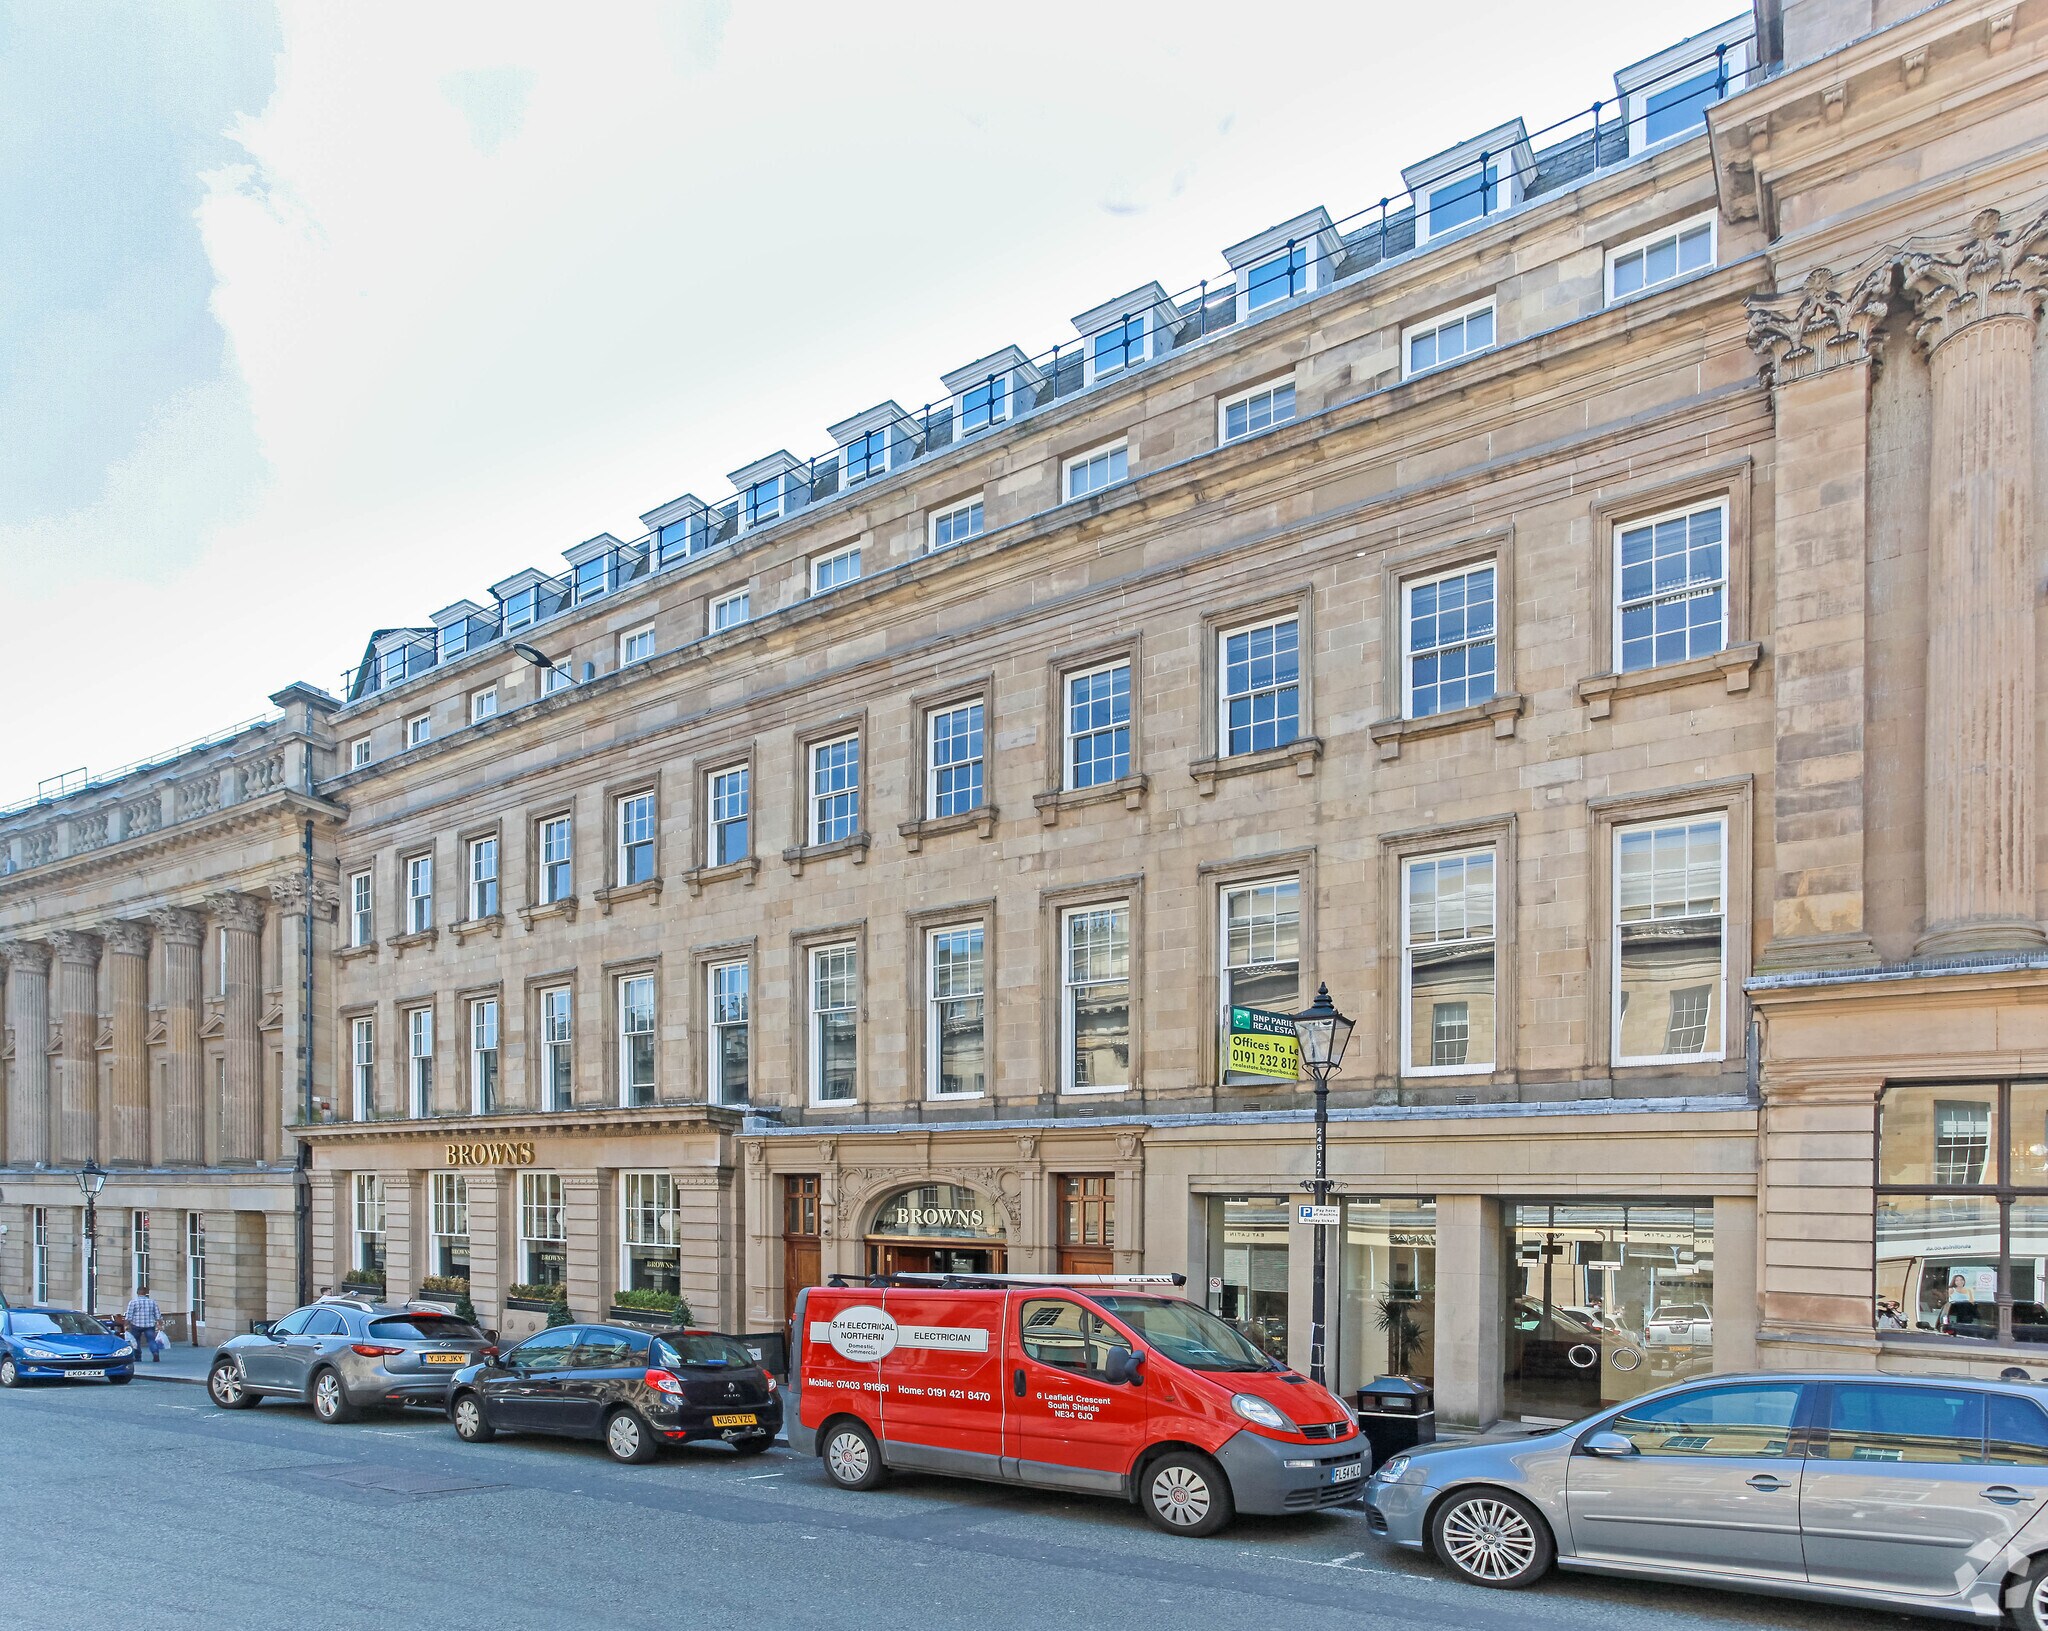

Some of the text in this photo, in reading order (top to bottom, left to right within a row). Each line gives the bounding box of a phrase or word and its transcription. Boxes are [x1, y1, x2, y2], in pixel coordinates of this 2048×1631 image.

[1253, 1013, 1269, 1022] BNP
[1253, 1022, 1273, 1032] REAL
[1233, 1036, 1269, 1050] Offices
[1273, 1043, 1285, 1053] To
[1233, 1049, 1297, 1070] 0191 232 812
[445, 1142, 535, 1165] BROWNS
[896, 1207, 984, 1226] BROWNS
[1303, 1207, 1312, 1217] P
[646, 1260, 674, 1268] BROWNS
[847, 1321, 895, 1331] ELECTRICAL
[840, 1332, 885, 1341] NORTHERN
[914, 1332, 971, 1342] ELECTRICIAN
[845, 1348, 878, 1356] Commercial
[808, 1377, 890, 1392] Mobile: 07403 191661
[898, 1385, 991, 1402] Home: 0191 421 8470
[1036, 1391, 1111, 1405] 6 Leafield Crescent
[1047, 1401, 1100, 1412] South Shields
[716, 1416, 737, 1424] NU60
[1054, 1410, 1094, 1420] NE34 6JQ
